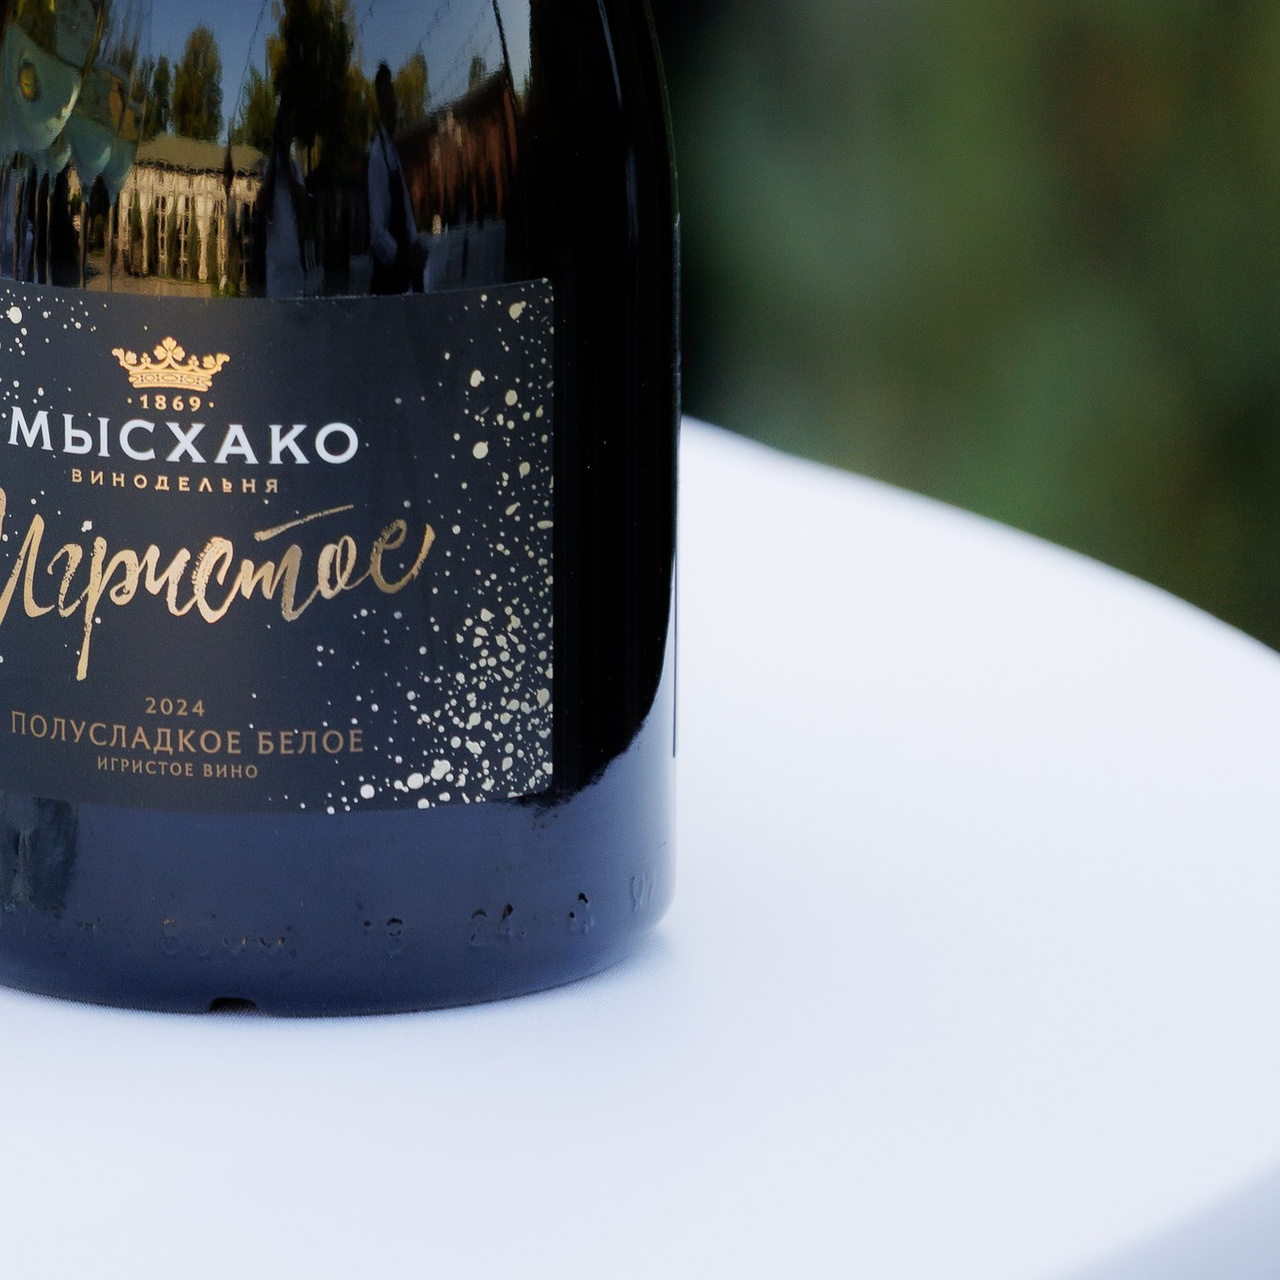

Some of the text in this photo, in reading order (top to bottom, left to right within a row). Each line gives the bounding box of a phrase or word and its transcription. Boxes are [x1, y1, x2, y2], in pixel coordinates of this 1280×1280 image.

[139, 393, 203, 413] 1869
[6, 406, 359, 466] МЫСХАКО
[70, 468, 280, 495] ВИНОДЕЛЬНЯ
[145, 696, 206, 718] 2024
[10, 710, 364, 756] ПОЛУСЛАДКОЕ БЕЛОЕ
[96, 756, 259, 780] ИГРИСТОЕ ВИНО
